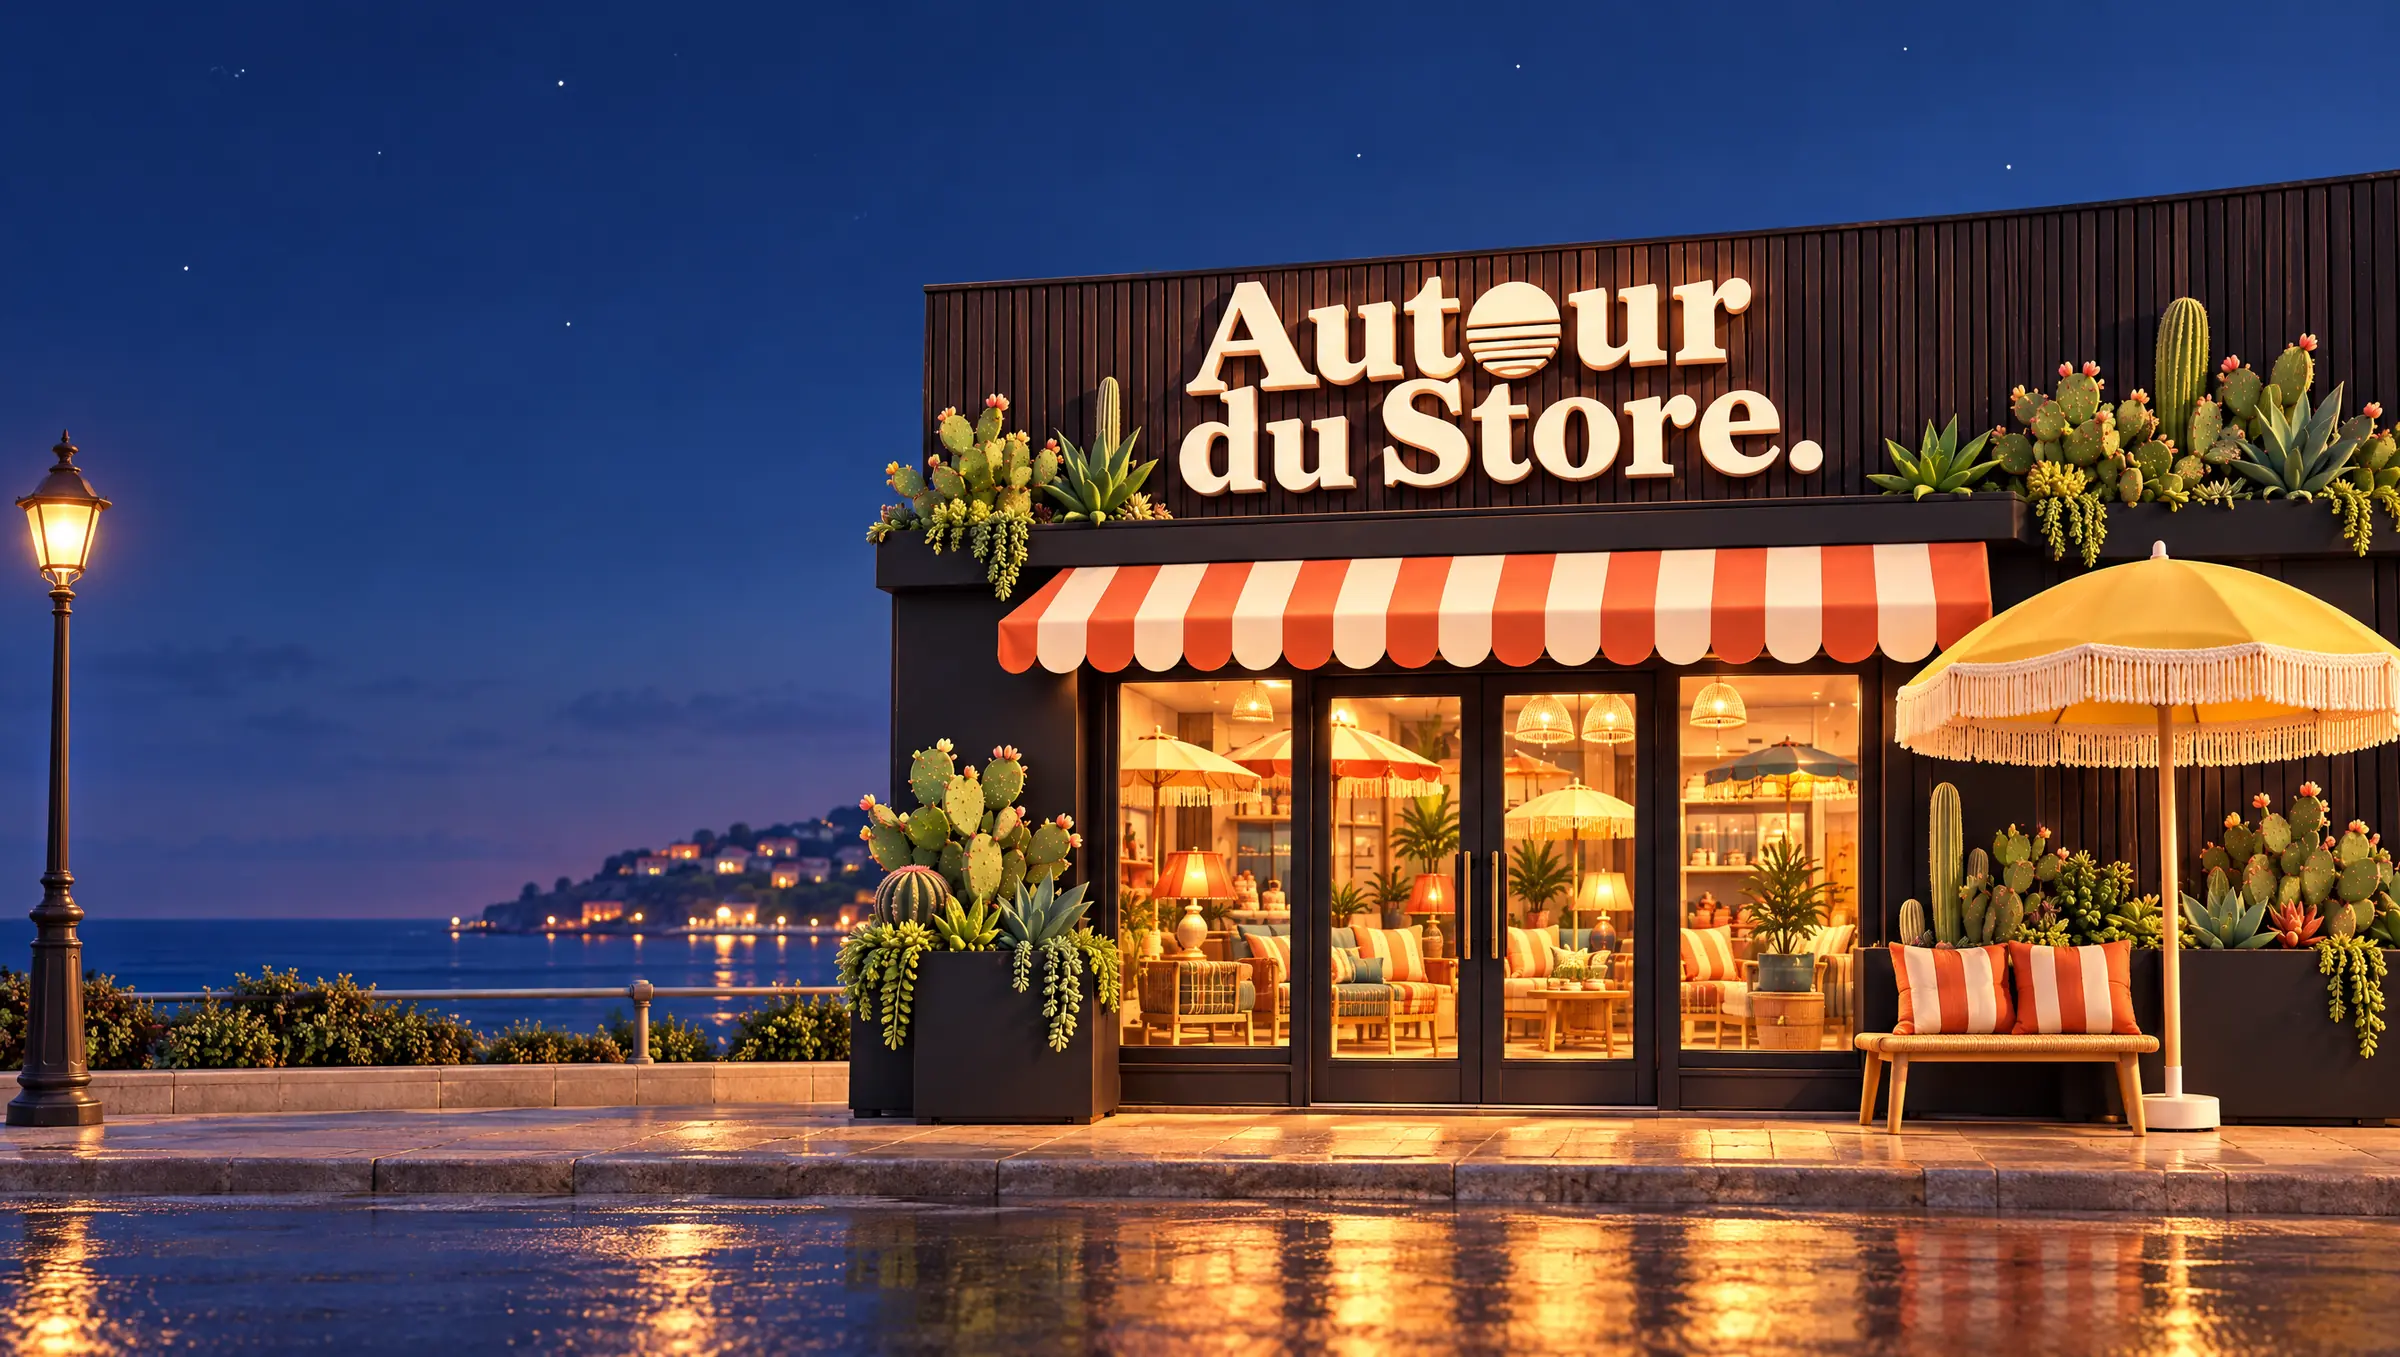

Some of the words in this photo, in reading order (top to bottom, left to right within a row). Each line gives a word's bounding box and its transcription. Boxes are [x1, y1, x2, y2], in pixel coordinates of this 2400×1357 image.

[1185, 276, 1753, 396] Autour
[1178, 385, 1358, 495] du
[1382, 378, 1824, 488] Store.
